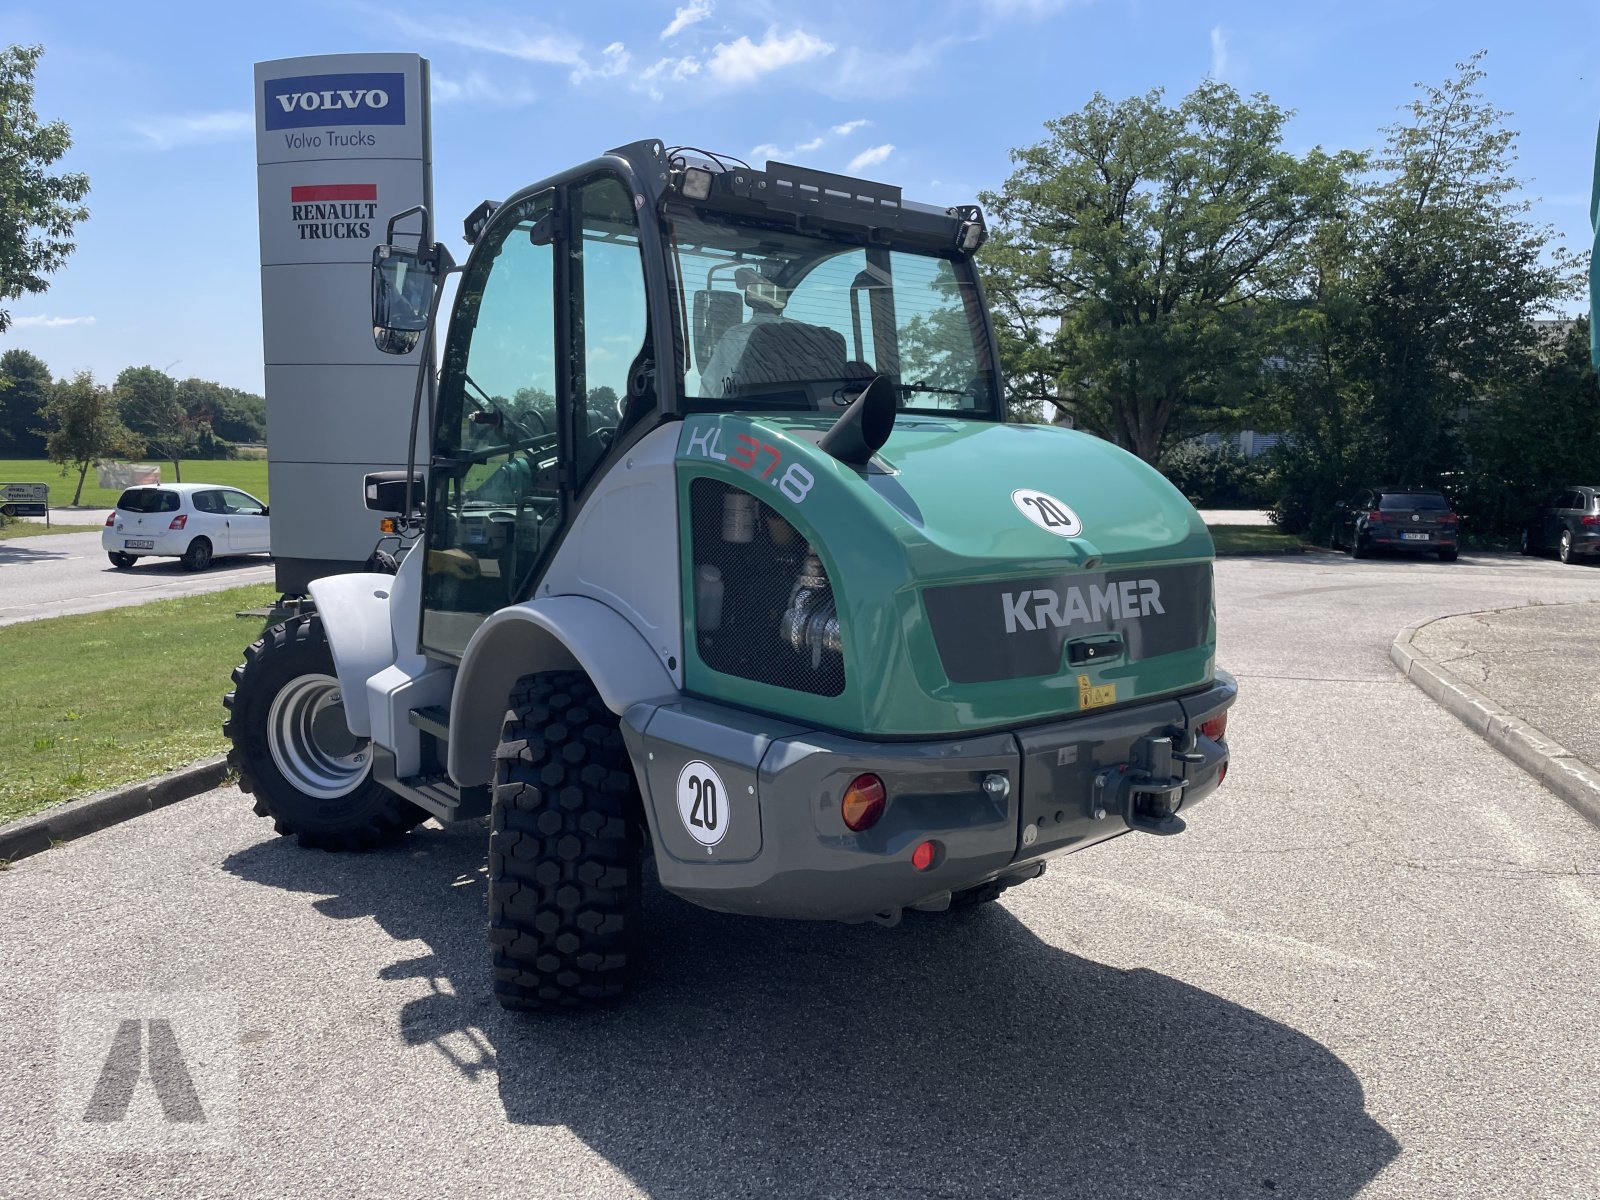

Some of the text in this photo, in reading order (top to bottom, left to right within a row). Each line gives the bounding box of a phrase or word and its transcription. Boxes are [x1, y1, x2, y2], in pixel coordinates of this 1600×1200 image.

[276, 89, 388, 112] VOLVO
[285, 130, 376, 149] Volvo Trucks
[292, 203, 377, 221] RENAULT
[298, 222, 371, 239] TRUCKS
[1022, 496, 1071, 527] 20
[1001, 579, 1165, 634] KRAMER
[688, 775, 717, 830] 20
